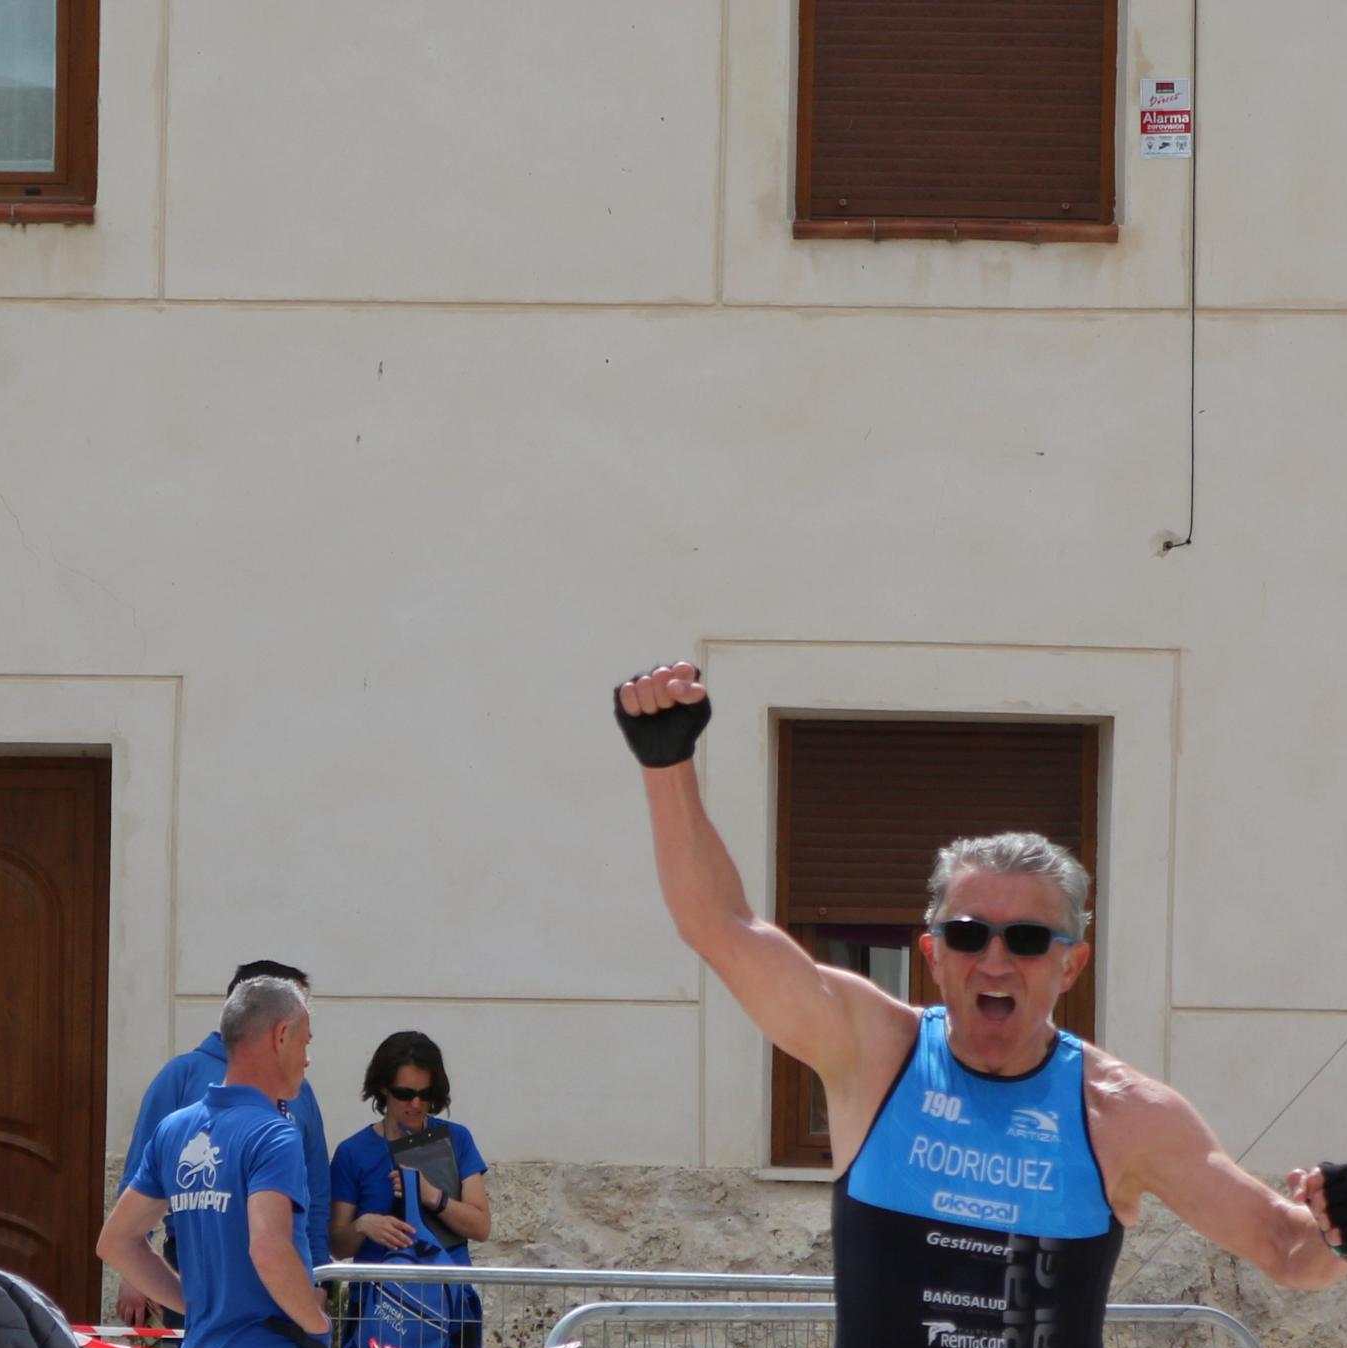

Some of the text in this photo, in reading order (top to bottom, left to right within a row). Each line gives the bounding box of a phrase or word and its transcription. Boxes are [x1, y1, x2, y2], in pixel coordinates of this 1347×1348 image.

[1142, 111, 1190, 124] Alarma
[908, 1135, 1055, 1191] RODRIGUEZ
[926, 1231, 1013, 1256] Gestinver
[923, 1290, 1008, 1311] BAÑOSALUD
